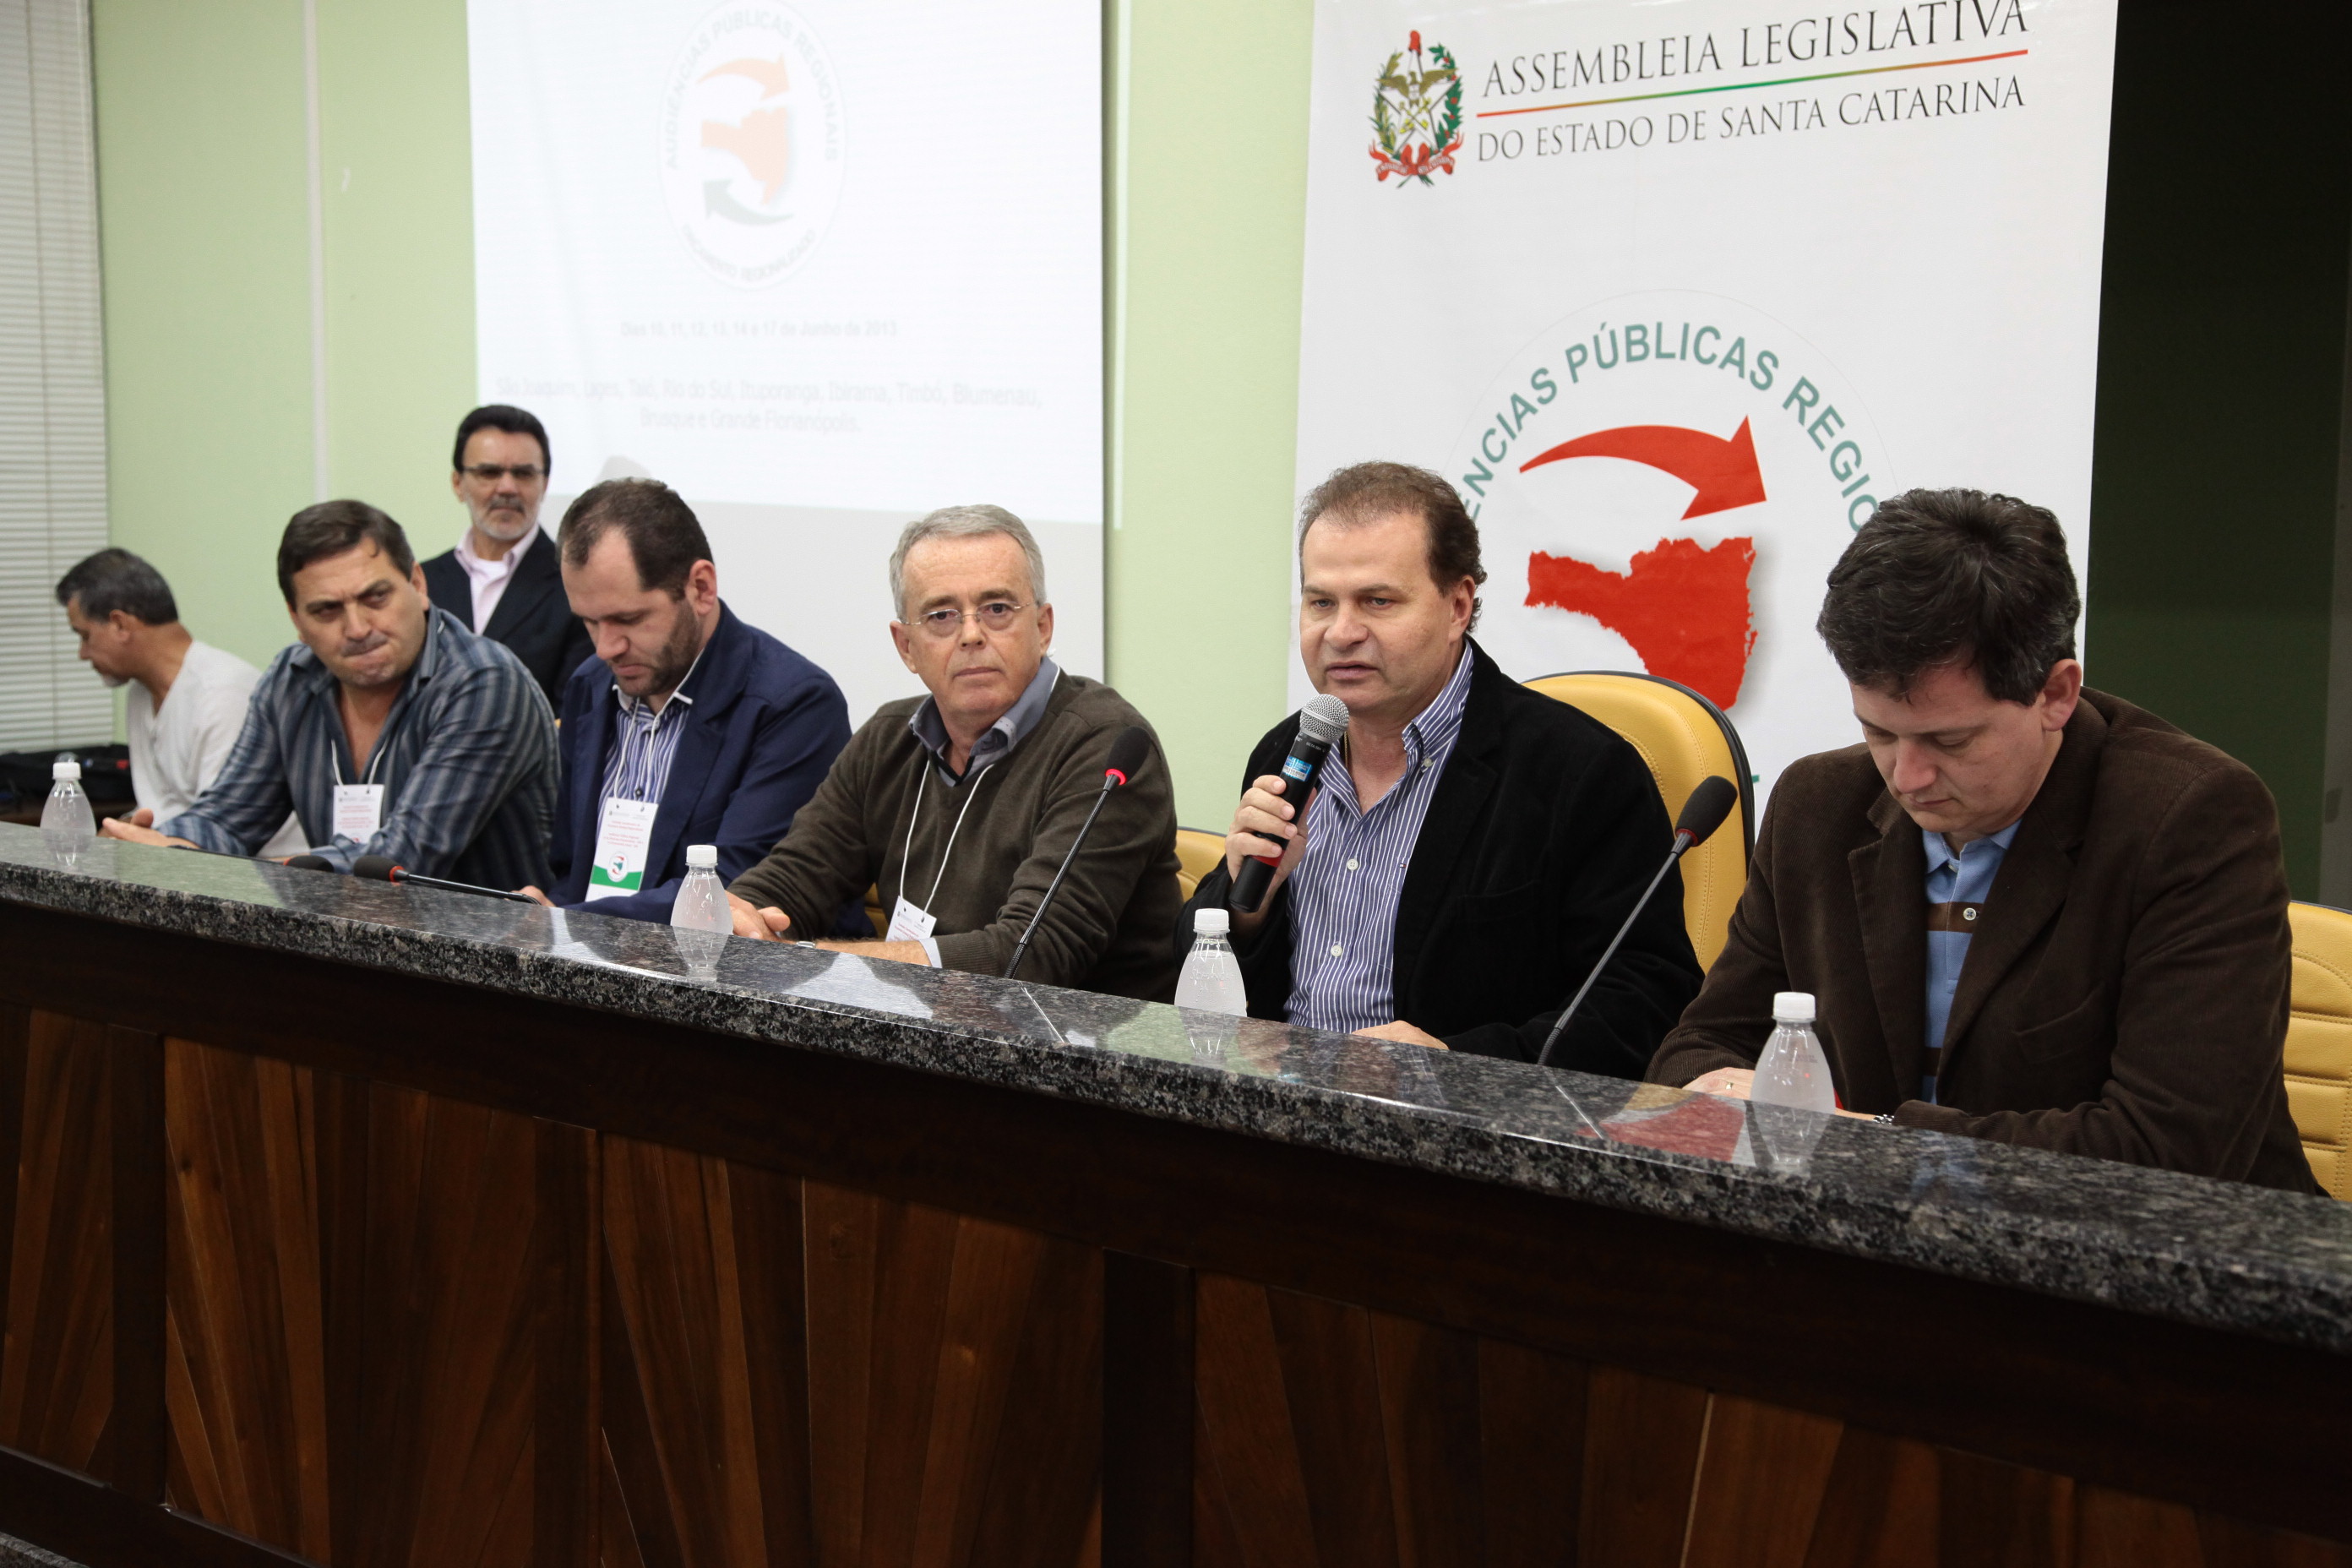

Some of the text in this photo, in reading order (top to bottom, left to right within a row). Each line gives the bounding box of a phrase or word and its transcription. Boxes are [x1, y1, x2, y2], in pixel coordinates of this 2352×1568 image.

[1482, 0, 2028, 98] ASSEMBLEIA LEGISLATIVA
[1477, 74, 2026, 162] DO ESTADO DE SANTA CATARINA
[1565, 322, 1780, 391] PÚBLICAS
